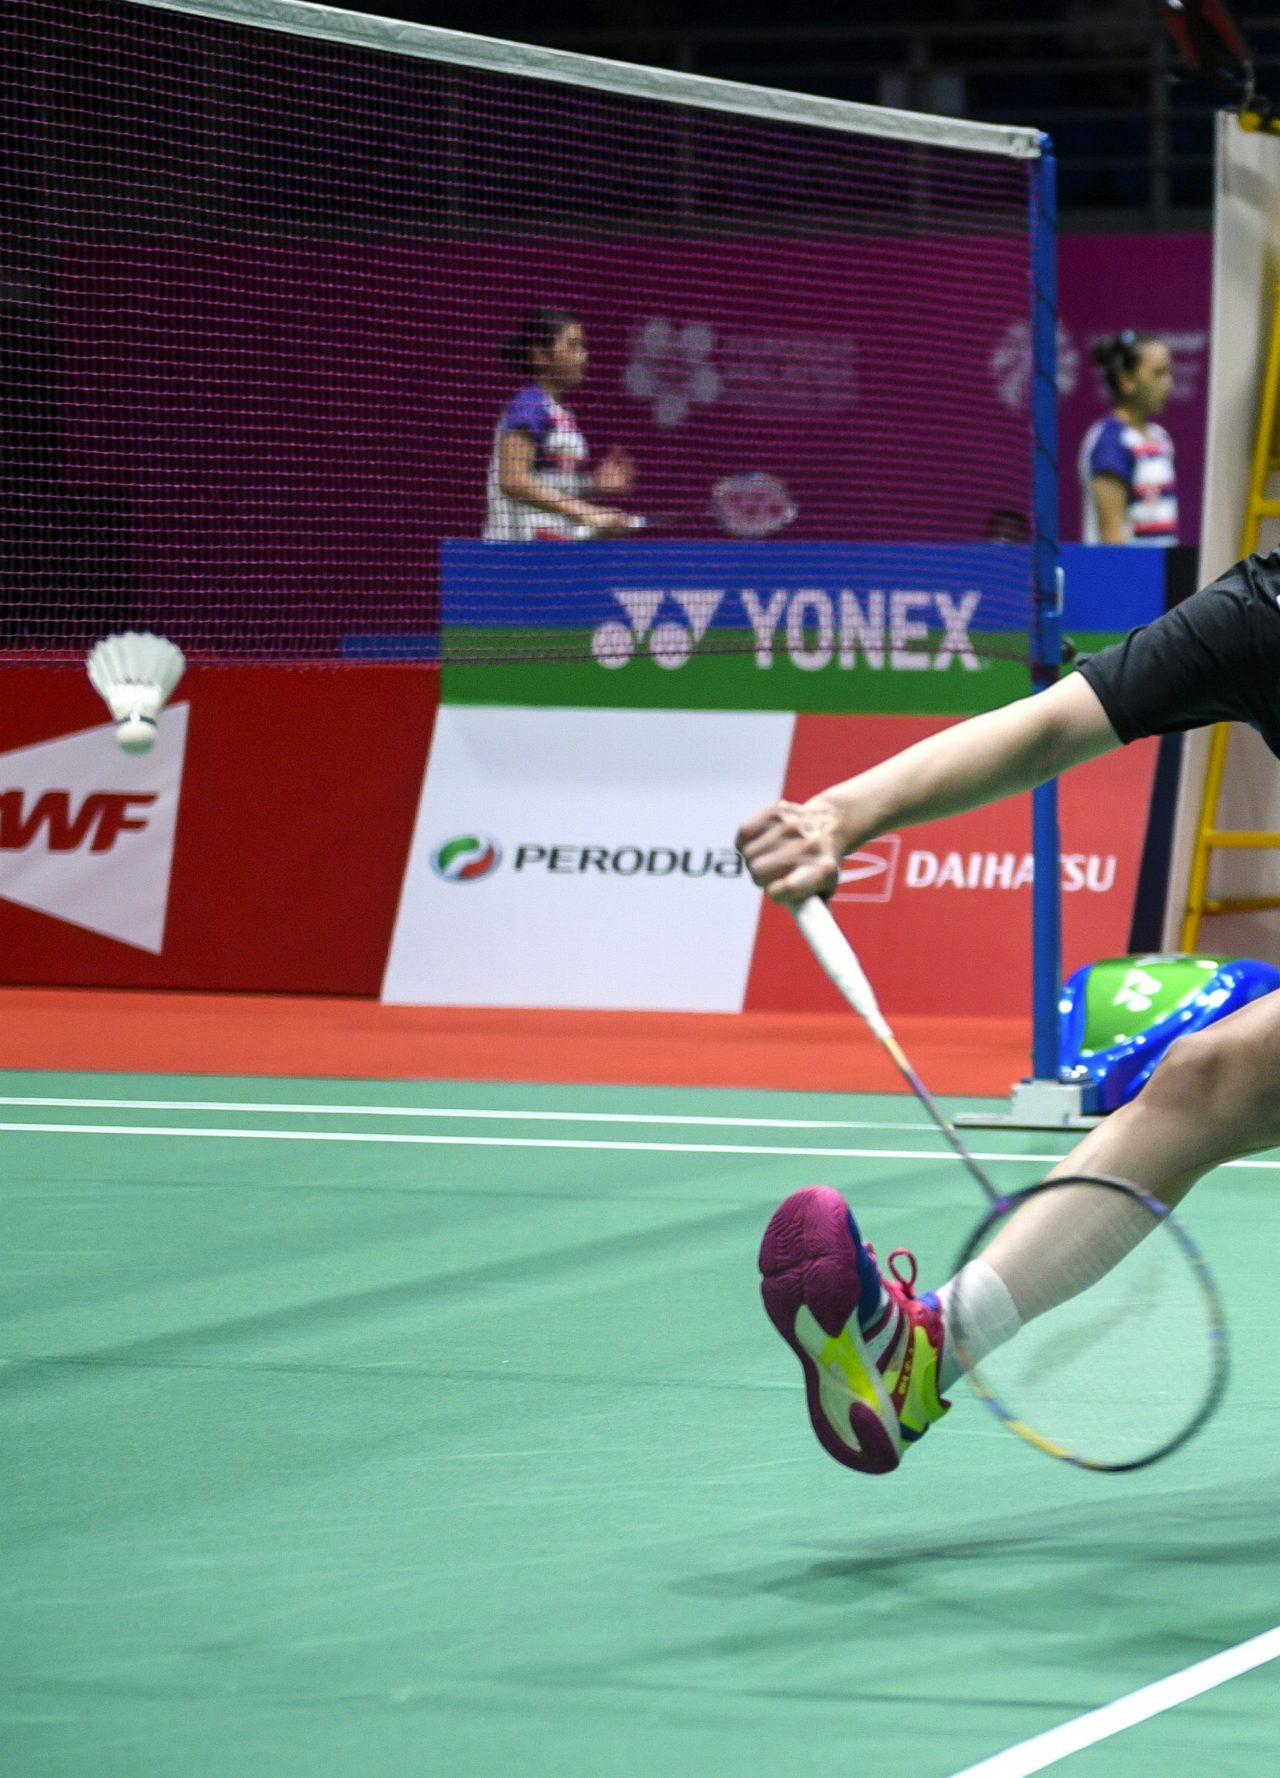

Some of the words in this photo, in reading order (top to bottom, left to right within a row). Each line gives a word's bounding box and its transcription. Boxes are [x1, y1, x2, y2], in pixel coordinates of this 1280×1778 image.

[741, 588, 982, 671] YONEX
[0, 787, 159, 854] WF
[907, 851, 1117, 892] DAIHASU
